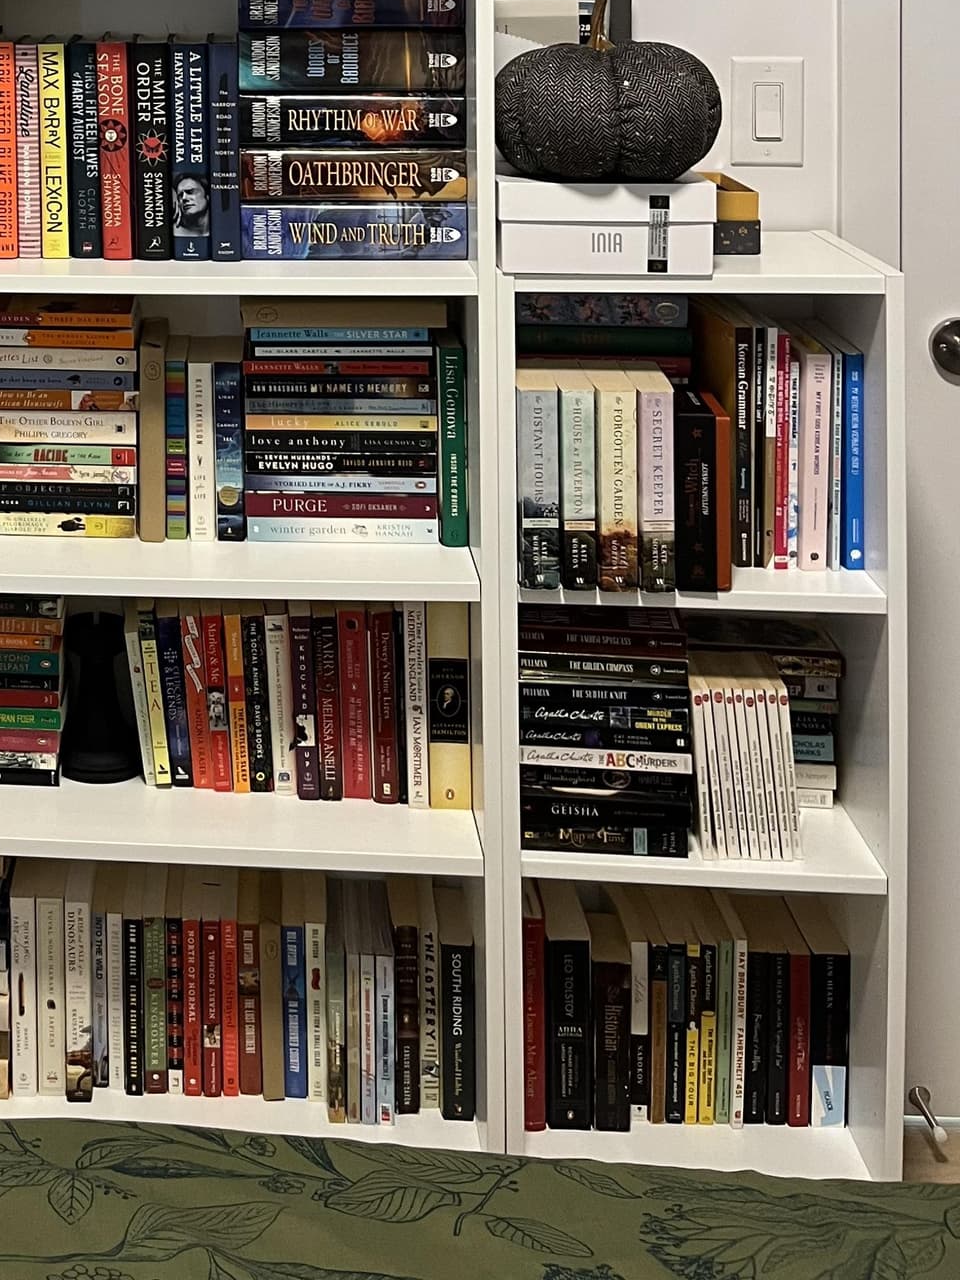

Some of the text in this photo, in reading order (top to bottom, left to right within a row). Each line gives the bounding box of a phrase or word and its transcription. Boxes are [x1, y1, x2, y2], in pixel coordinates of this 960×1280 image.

[42, 51, 59, 90] MAX
[137, 63, 150, 122] ORDER
[153, 80, 166, 125] MIME
[174, 52, 184, 163] HANYA YANAGIHARA
[189, 52, 202, 163] A LITTLE LIFE
[288, 109, 362, 131] RHYTHM
[381, 109, 419, 131] WAR
[289, 161, 422, 188] OATHBRINGER
[144, 172, 153, 227] SHANNON
[155, 172, 163, 227] SAMANTHA
[289, 223, 426, 245] WIND AND TRUTH
[591, 233, 623, 254] INIA
[738, 343, 749, 430] Korean Grammar
[252, 436, 346, 447] love anthony
[258, 462, 333, 470] EVELYN HUGO
[653, 411, 663, 516] SECRET KEEPER
[273, 499, 328, 513] PURGE
[606, 752, 677, 769] ABC MURDERS
[551, 805, 599, 816] GEISHA
[452, 954, 462, 1036] SOUTH RIDING
